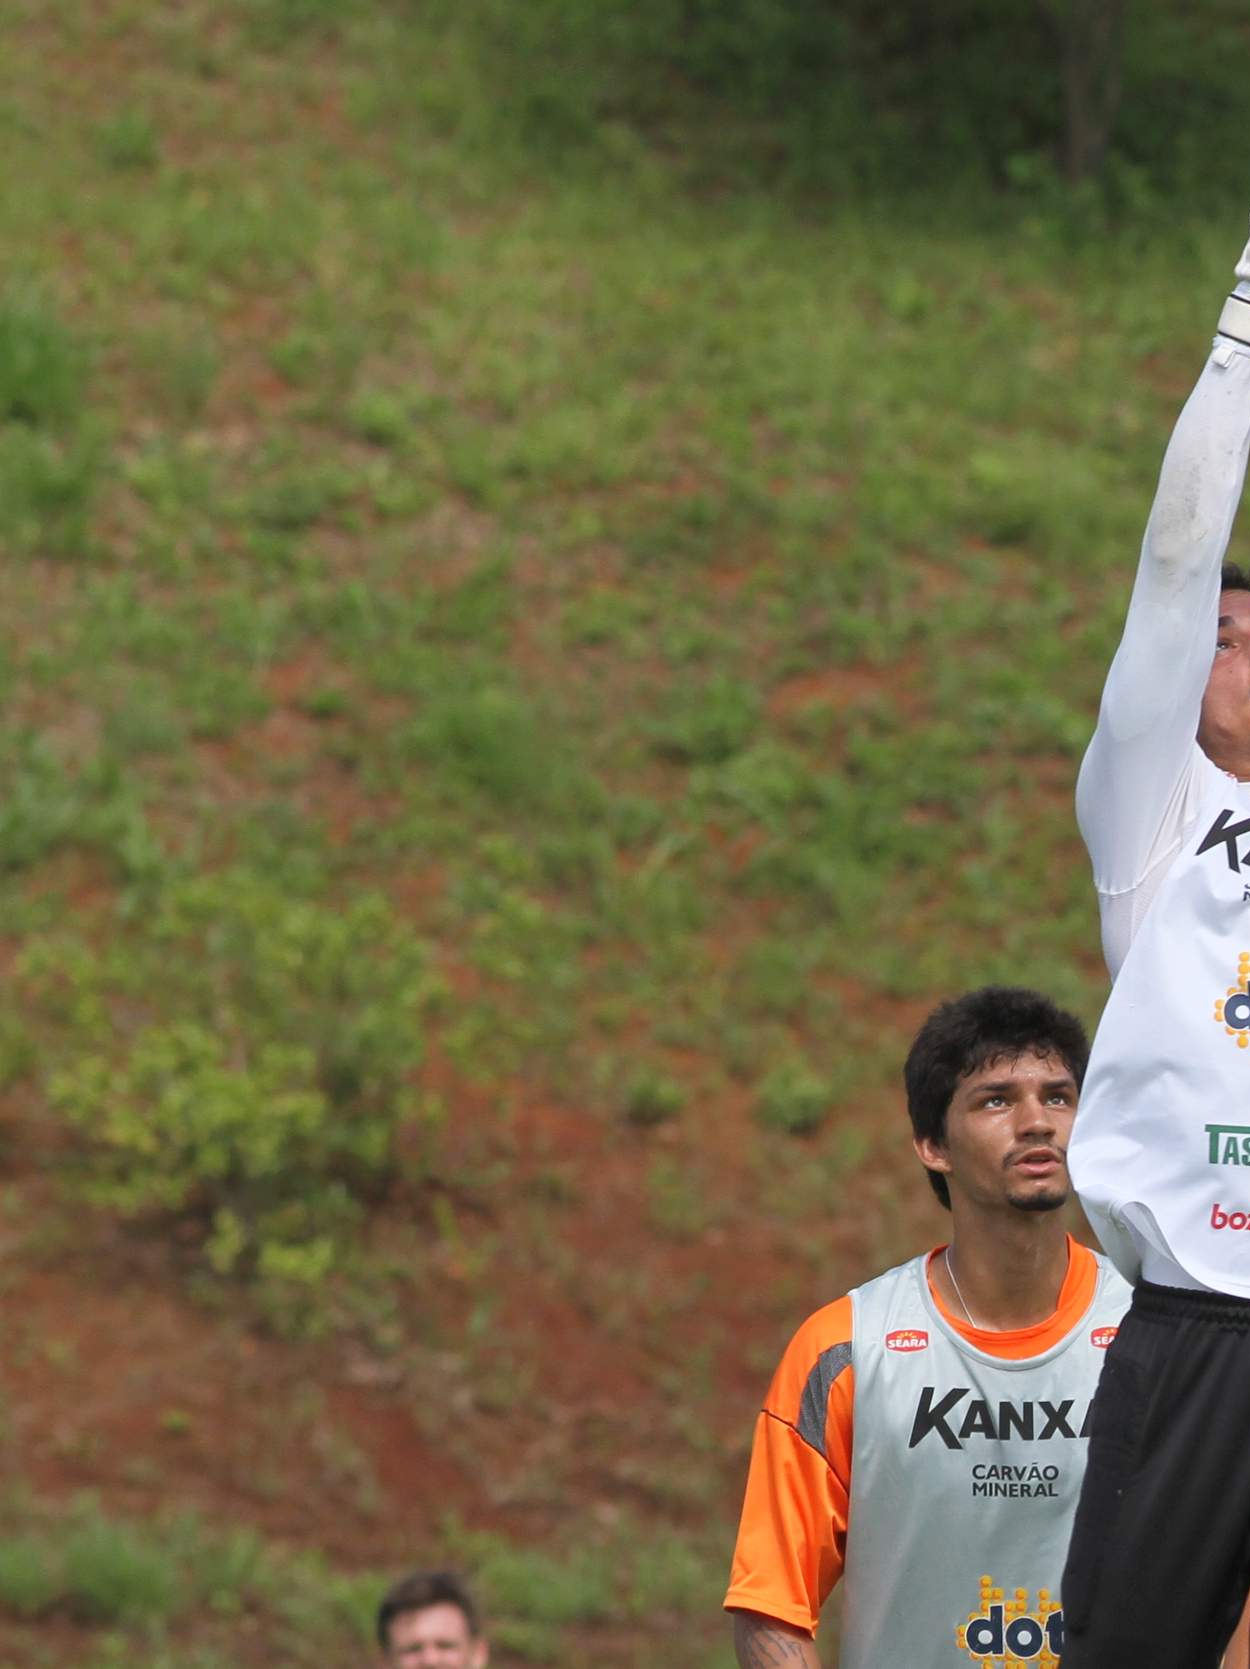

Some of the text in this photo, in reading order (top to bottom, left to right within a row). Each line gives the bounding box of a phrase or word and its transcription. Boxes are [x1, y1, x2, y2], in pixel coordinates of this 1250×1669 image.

[887, 1338, 928, 1349] SEARA
[972, 1463, 1059, 1481] CARVÃO
[972, 1482, 1059, 1498] MINERAL
[966, 1604, 1064, 1658] dot
